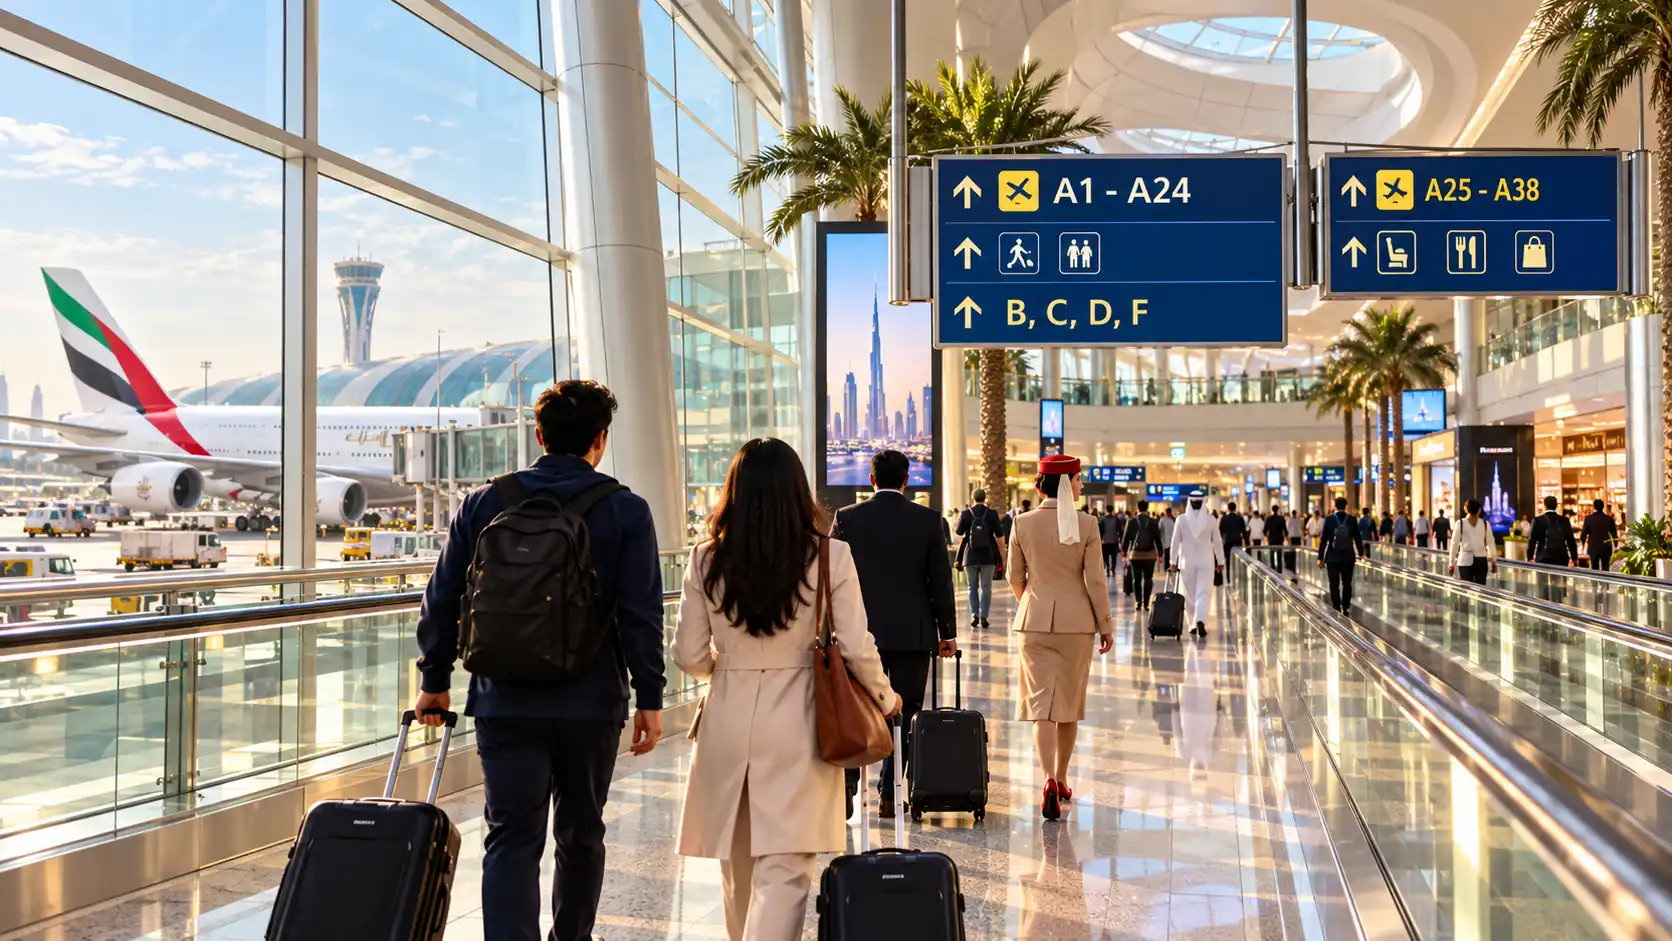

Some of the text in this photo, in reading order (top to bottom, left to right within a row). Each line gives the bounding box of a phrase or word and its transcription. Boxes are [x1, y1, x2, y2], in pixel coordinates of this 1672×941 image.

[1053, 177, 1092, 204] A1
[1127, 177, 1191, 204] A24
[1424, 177, 1472, 202] A25
[1493, 177, 1540, 202] A38
[1007, 298, 1149, 330] B, C, D, F
